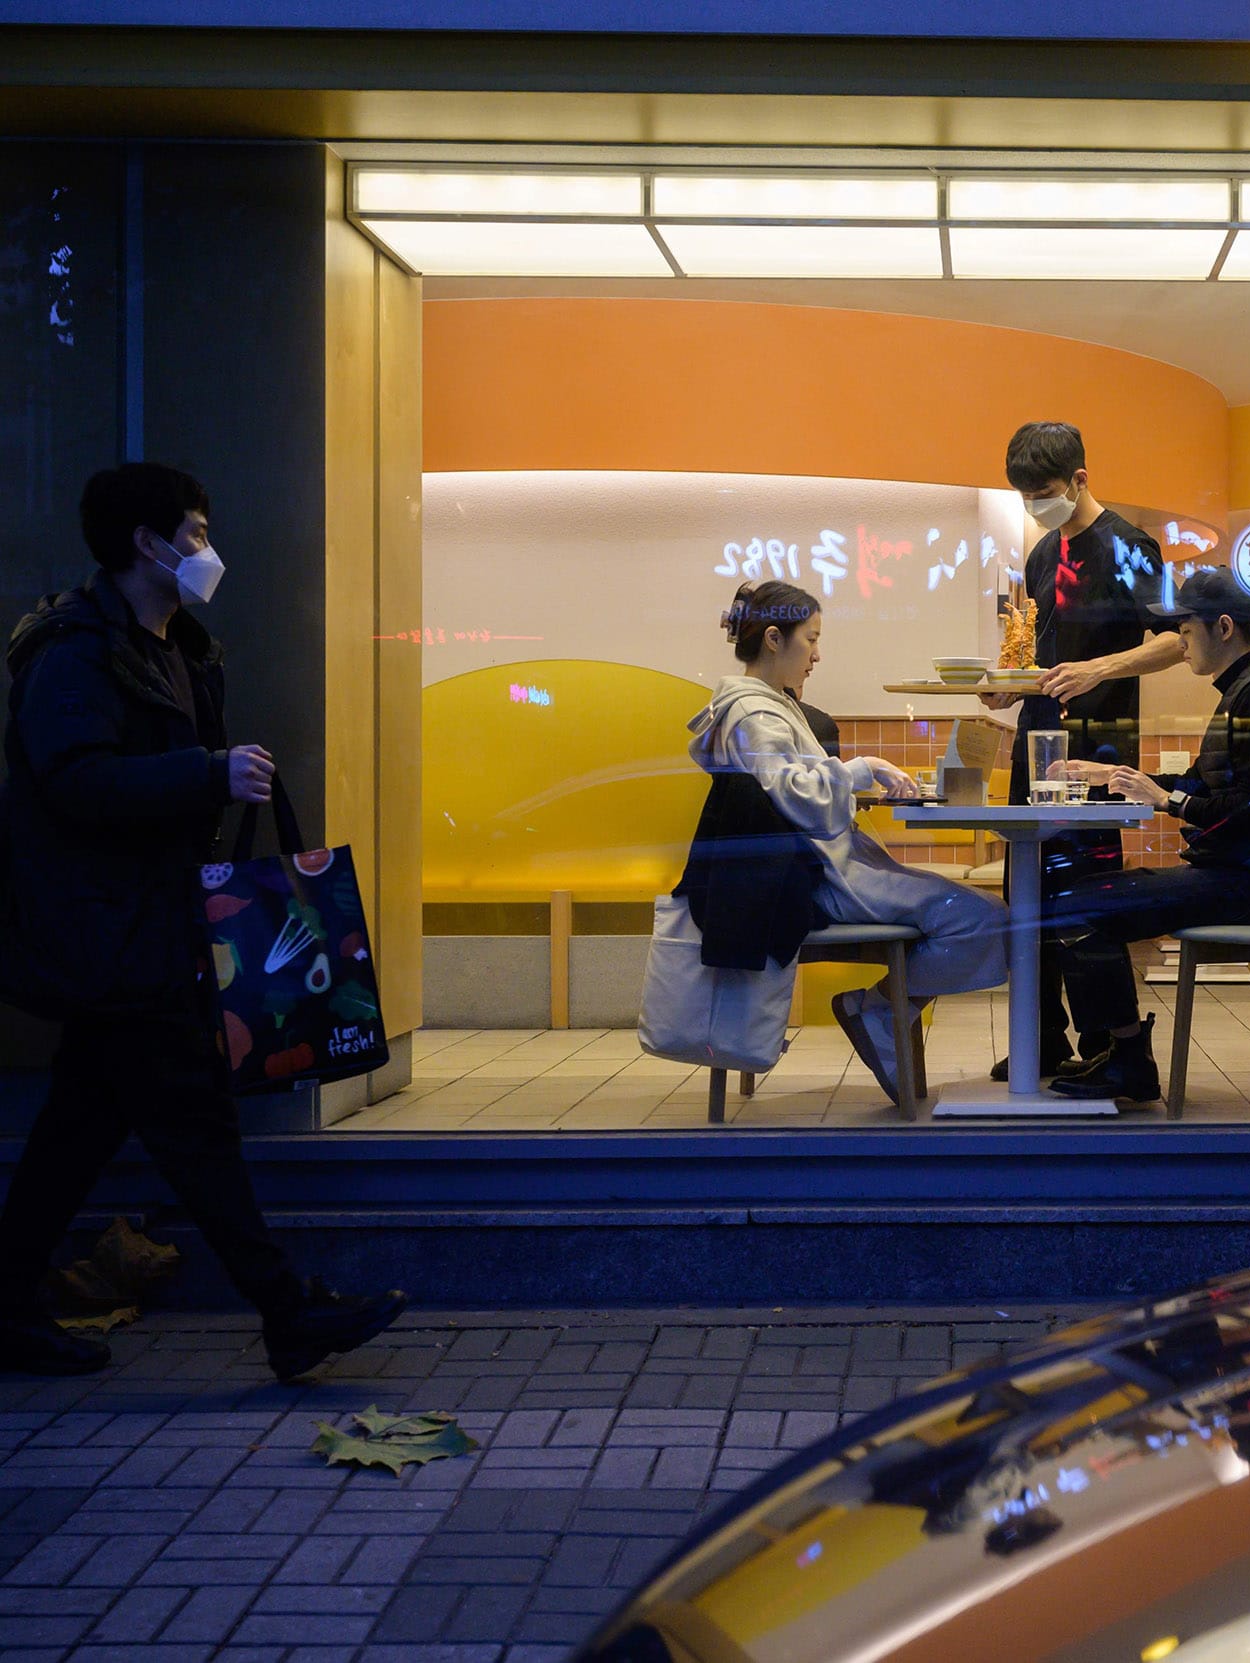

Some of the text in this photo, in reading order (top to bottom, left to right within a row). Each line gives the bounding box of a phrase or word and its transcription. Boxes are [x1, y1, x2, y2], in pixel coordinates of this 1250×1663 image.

[328, 1030, 375, 1058] fresh!
[333, 1025, 358, 1043] I am
